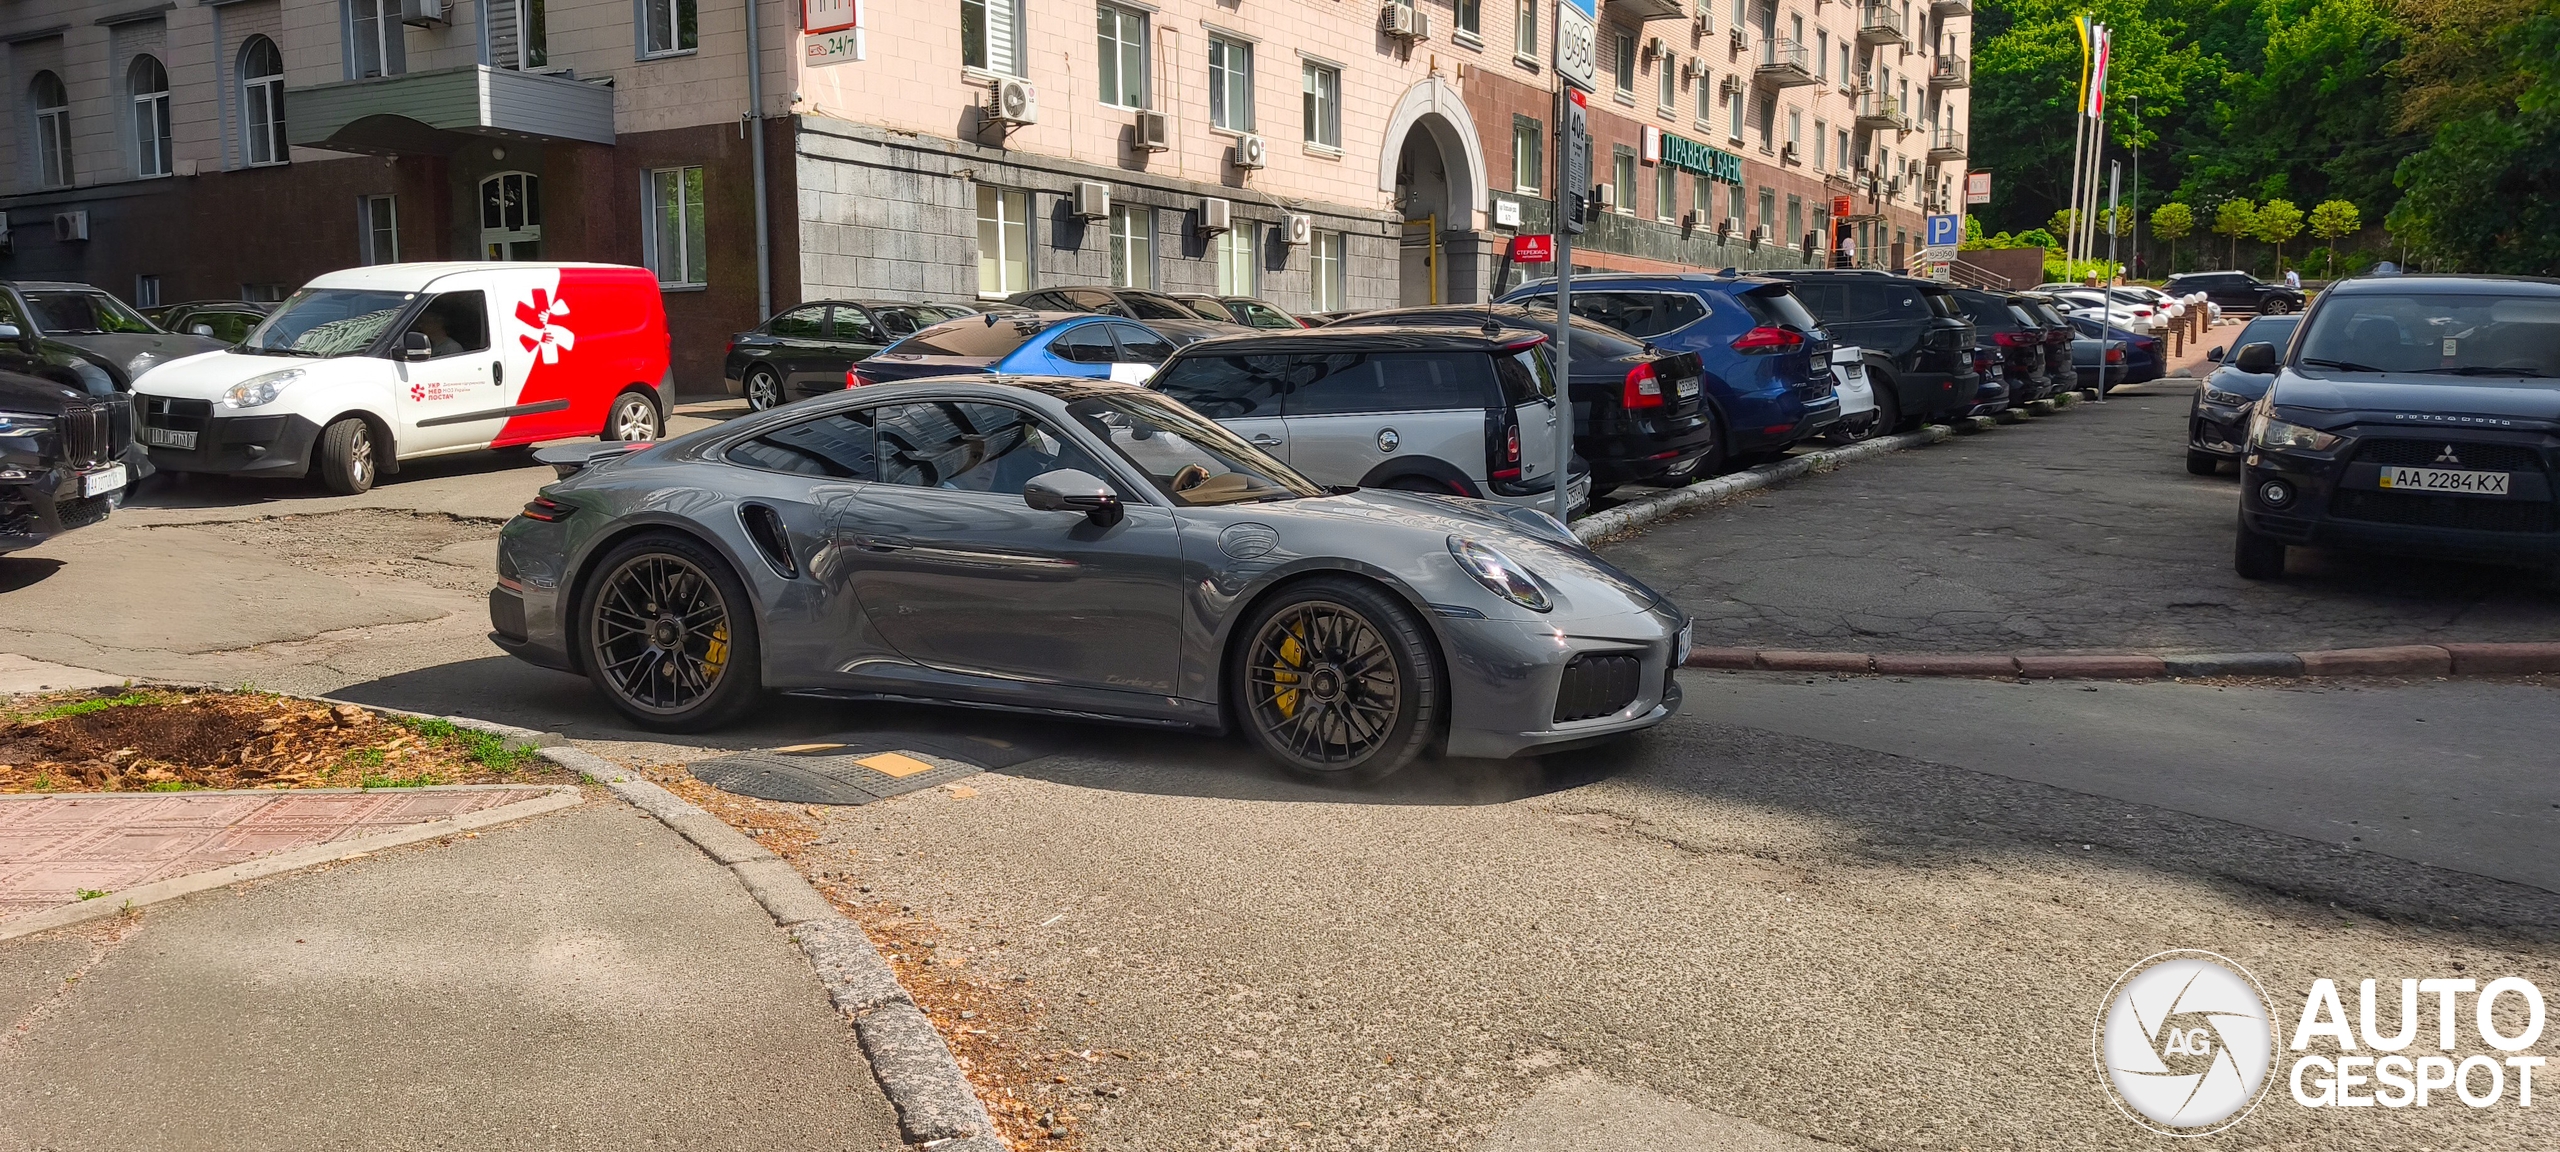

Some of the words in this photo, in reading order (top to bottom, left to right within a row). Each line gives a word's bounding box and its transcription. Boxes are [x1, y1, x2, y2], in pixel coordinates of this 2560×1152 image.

[828, 35, 854, 56] 24/7
[1565, 29, 1570, 49] 10
[1582, 37, 1592, 67] 50
[1665, 134, 1714, 174] ПРАВЕКС
[1716, 149, 1744, 185] БАНК
[1935, 217, 1952, 243] P
[2395, 414, 2510, 425] OUTLANDER
[2396, 470, 2421, 486] AA
[2427, 472, 2472, 490] 2284
[2477, 475, 2506, 491] KX
[1106, 674, 1151, 686] Turbo
